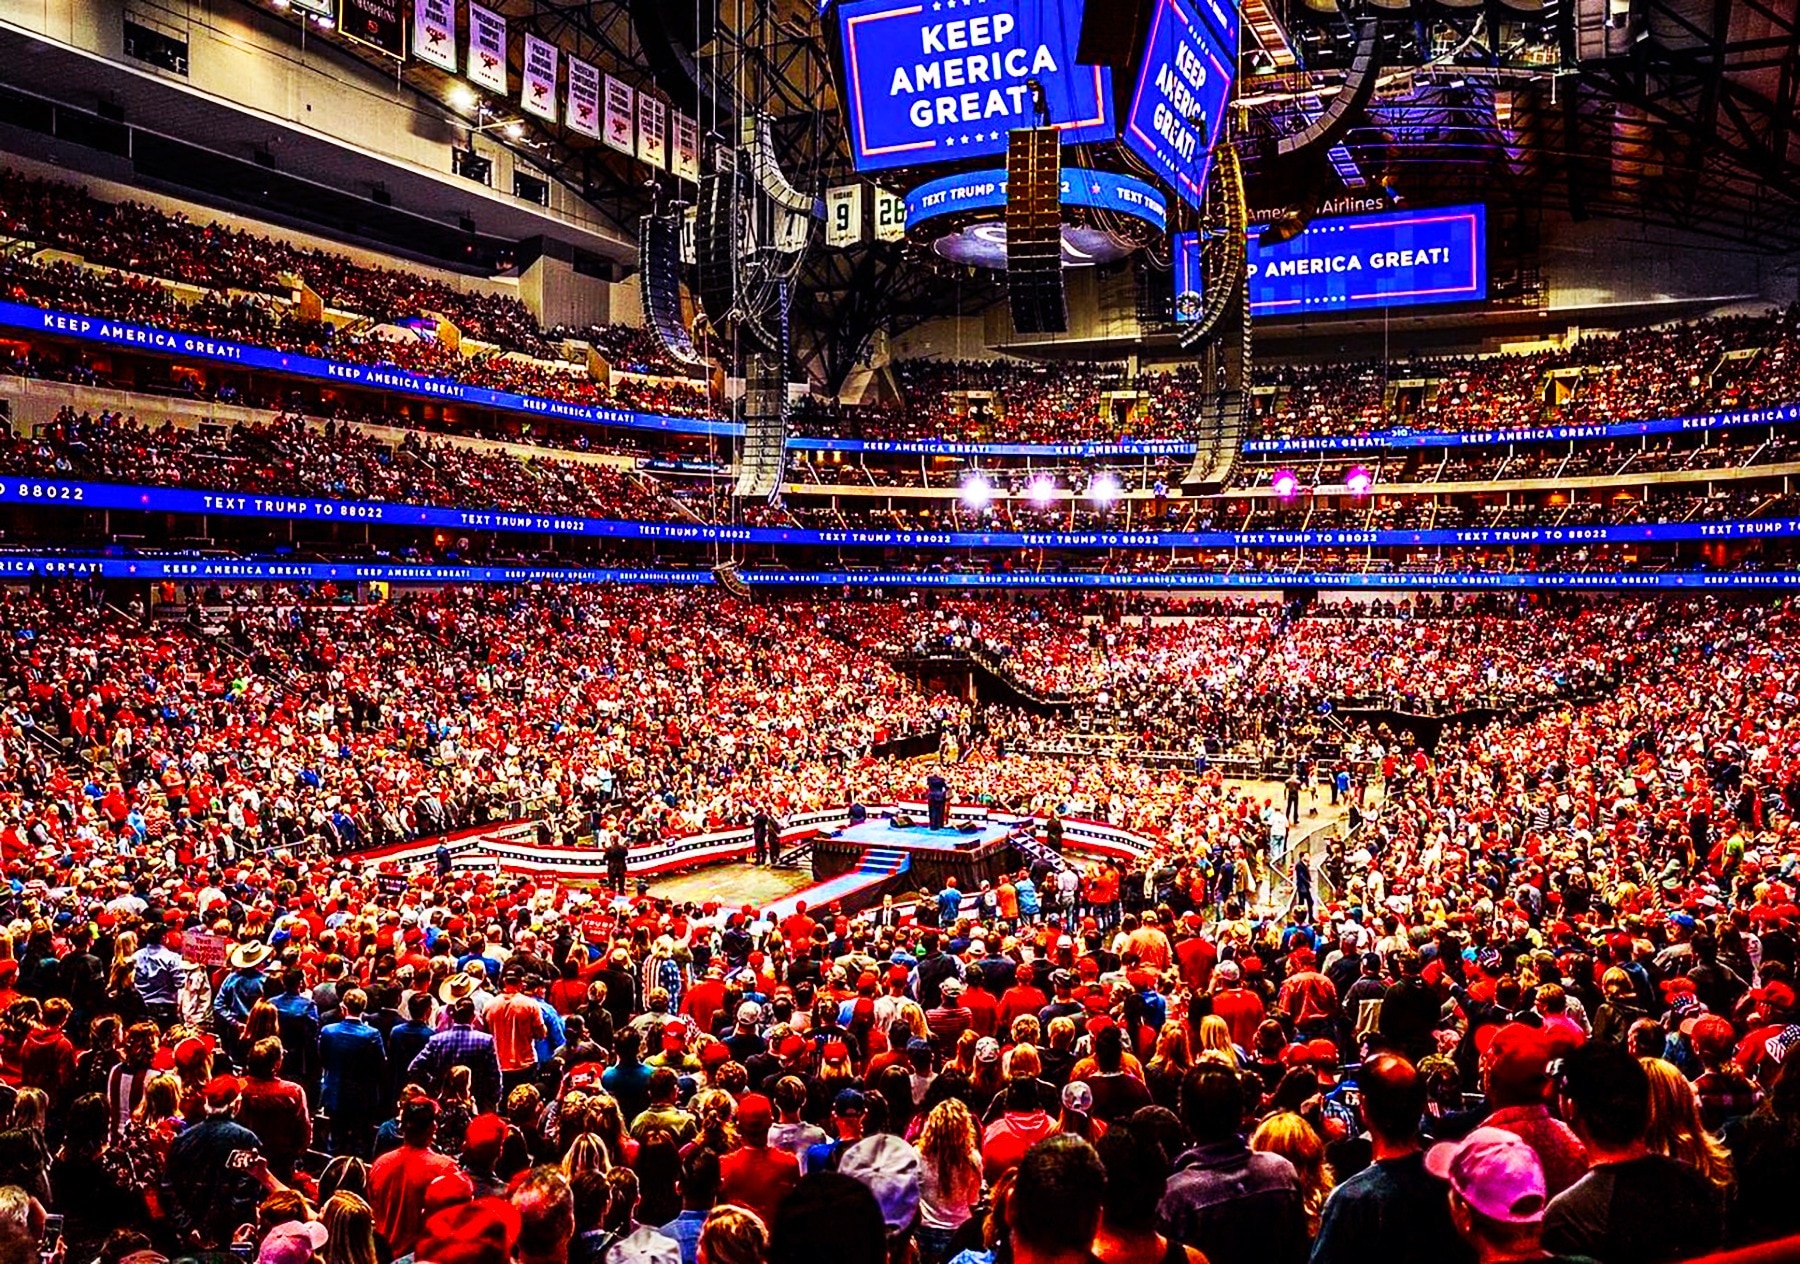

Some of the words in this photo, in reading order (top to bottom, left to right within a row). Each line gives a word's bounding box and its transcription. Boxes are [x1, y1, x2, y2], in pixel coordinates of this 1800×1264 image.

[921, 14, 1015, 54] KEEP
[890, 44, 1057, 96] AMERICA
[1176, 40, 1206, 91] KEEP
[1153, 103, 1196, 163] GREAT!
[922, 191, 946, 208] TEXT
[950, 183, 994, 201] TRUMP
[1116, 187, 1143, 204] TEXT
[880, 197, 905, 225] 26
[1322, 197, 1384, 213] Airlines
[837, 203, 849, 231] 9
[1265, 255, 1362, 278] AMERICA
[1370, 248, 1449, 269] GREAT!
[44, 314, 90, 332] KEEP
[100, 324, 176, 348] AMERICA
[185, 339, 240, 359] GREAT!
[328, 364, 360, 378] KEEP
[366, 372, 419, 389] AMERICA
[424, 382, 464, 397] GREAT!
[523, 399, 547, 411] KEEP
[551, 404, 592, 418] AMERICA
[596, 411, 634, 423] GREAT!
[1682, 416, 1716, 428] KEEP
[1722, 410, 1783, 425] AMERICA
[1461, 434, 1492, 443] KEEP
[1497, 428, 1553, 441] AMERICA
[1559, 427, 1607, 437] GREAT!
[863, 442, 890, 450] KEEP
[895, 443, 944, 453] AMERICA
[949, 444, 990, 454] GREAT!
[1054, 446, 1083, 454] KEEP
[1088, 445, 1138, 454] AMERICA
[1143, 445, 1184, 454] GREAT!
[1250, 442, 1279, 451] KEEP
[1283, 438, 1337, 450] AMERICA
[1341, 438, 1386, 447] GREAT!
[19, 484, 83, 500] 88022
[203, 496, 246, 510] TEXT
[255, 500, 307, 513] TRUMP
[315, 503, 333, 515] TO
[340, 505, 382, 518] 88022
[461, 513, 490, 525] TEXT
[495, 516, 532, 527] TRUMP
[536, 518, 550, 529] TO
[554, 520, 584, 531] 88022
[1701, 525, 1732, 535] TEXT
[1738, 523, 1782, 533] TRUMP
[639, 525, 660, 535] TEXT
[665, 527, 698, 537] TRUMP
[702, 528, 715, 538] TO
[720, 529, 750, 539] 88022
[819, 532, 846, 541] TEXT
[852, 533, 891, 542] TRUMP
[896, 534, 911, 542] TO
[916, 534, 951, 543] 88022
[1022, 535, 1052, 544] TEXT
[1057, 535, 1097, 544] TRUMP
[1102, 535, 1117, 544] TO
[1122, 535, 1159, 544] 88022
[1234, 535, 1264, 543] TEXT
[1270, 535, 1311, 543] TRUMP
[1317, 534, 1332, 543] TO
[1338, 534, 1377, 542] 88022
[1457, 532, 1489, 541] TEXT
[1494, 532, 1539, 541] TRUMP
[1545, 531, 1562, 539] TO
[1569, 530, 1607, 539] 88022
[46, 562, 103, 572] GREAT!
[163, 565, 197, 573] KEEP
[205, 566, 262, 574] AMERICA
[268, 567, 312, 575] GREAT!
[356, 568, 382, 576] KEEP
[388, 569, 432, 577] AMERICA
